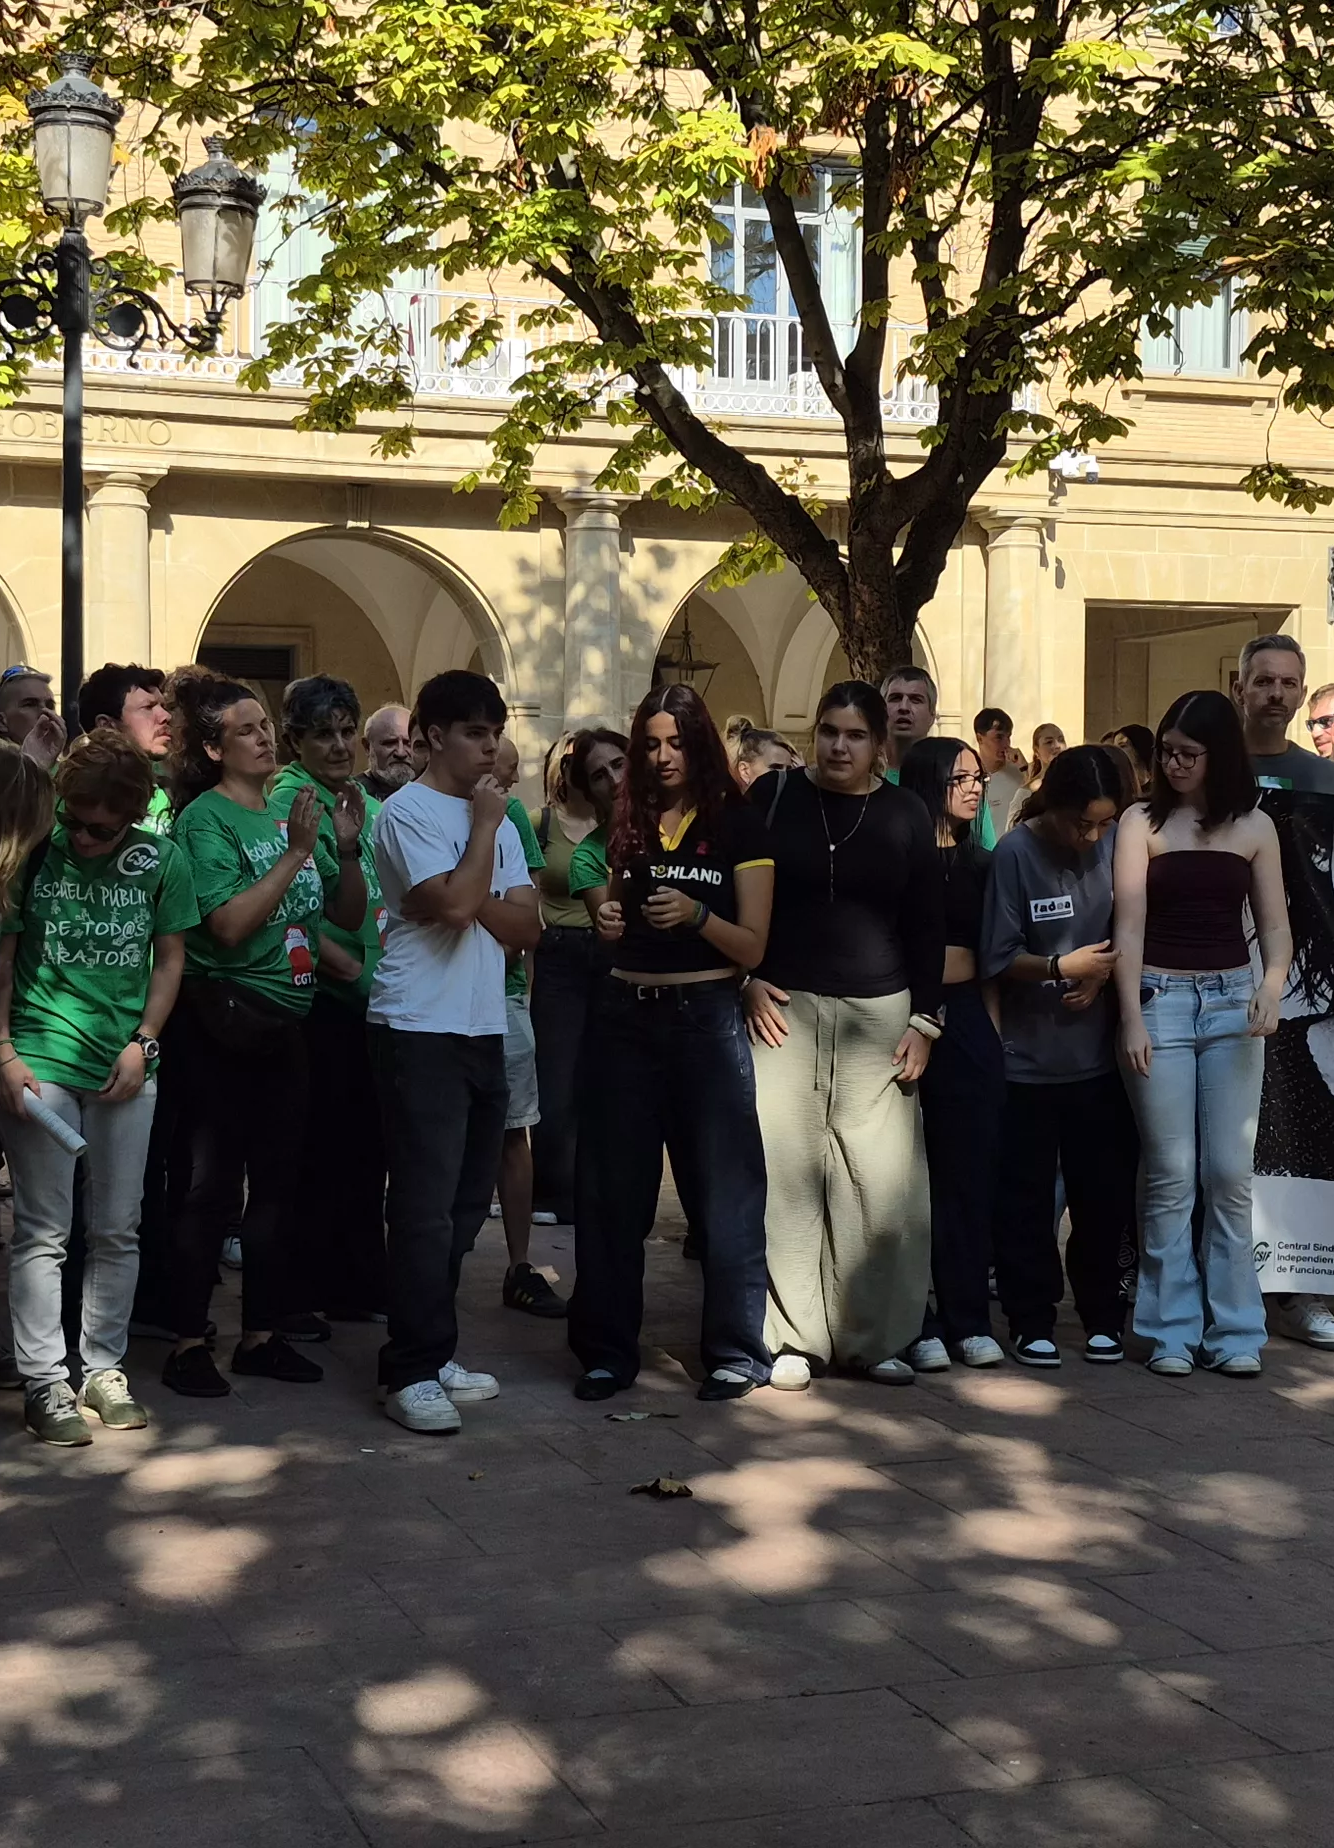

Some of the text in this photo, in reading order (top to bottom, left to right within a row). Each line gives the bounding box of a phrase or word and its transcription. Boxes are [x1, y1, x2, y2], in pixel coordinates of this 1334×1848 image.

[44, 920, 71, 936] DE
[294, 972, 312, 986] CGT
[1277, 1241, 1311, 1251] Central
[1276, 1265, 1287, 1273] de
